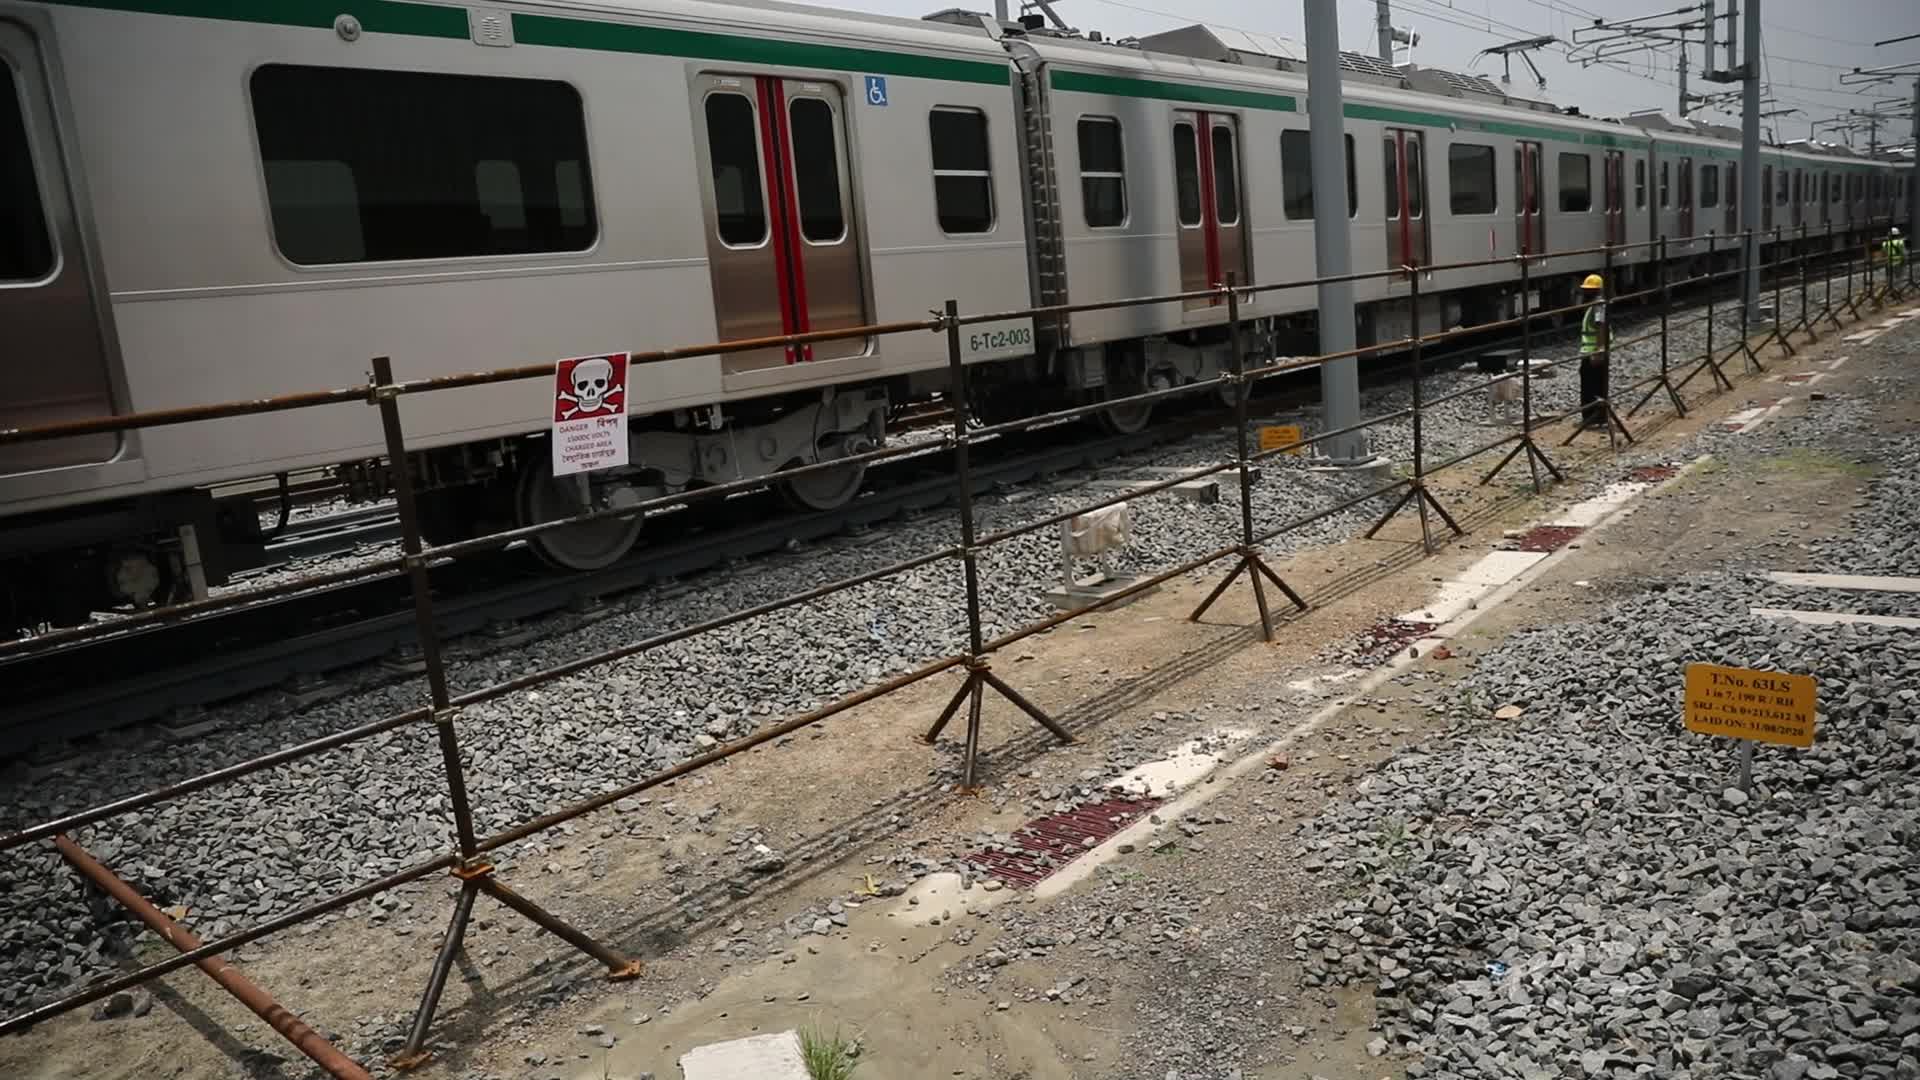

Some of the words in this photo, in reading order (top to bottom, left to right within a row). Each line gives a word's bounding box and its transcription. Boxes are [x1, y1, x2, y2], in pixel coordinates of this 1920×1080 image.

[970, 328, 1031, 351] 6-Tc2-003
[559, 423, 588, 433] DANGER
[565, 442, 595, 453] CHARGED
[596, 440, 612, 448] AREA
[1711, 672, 1749, 688] T.No.
[1753, 679, 1791, 693] 63LS
[1713, 690, 1723, 698] in
[1758, 695, 1767, 704] R
[1776, 697, 1795, 707] RH
[1694, 712, 1722, 726] LAID
[1795, 713, 1806, 723] M
